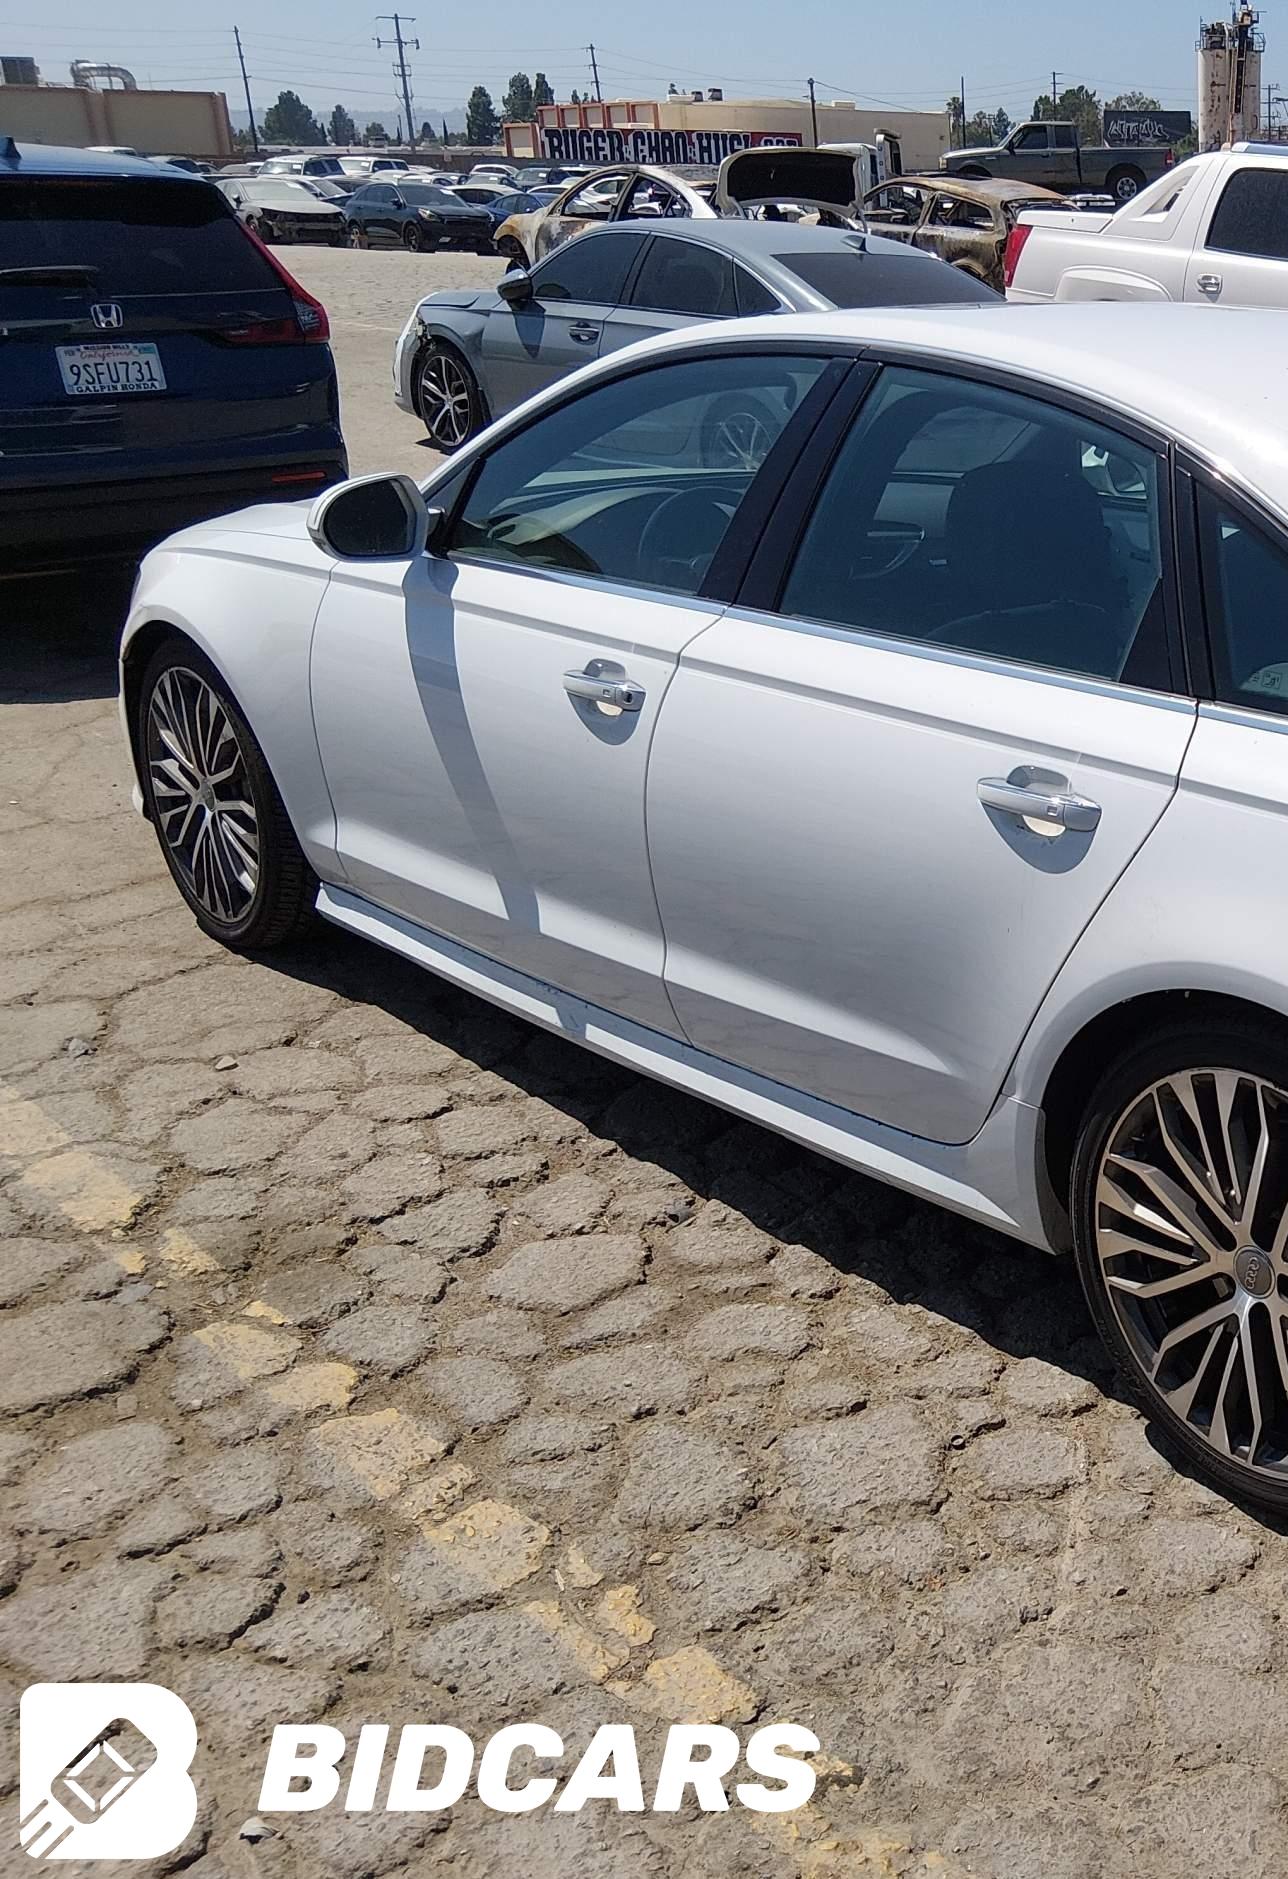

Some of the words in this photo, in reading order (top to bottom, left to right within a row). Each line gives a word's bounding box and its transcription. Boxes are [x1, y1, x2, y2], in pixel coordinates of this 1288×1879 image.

[69, 360, 159, 386] 9SFU731
[76, 384, 118, 393] GALPIN
[121, 382, 159, 391] HONDA
